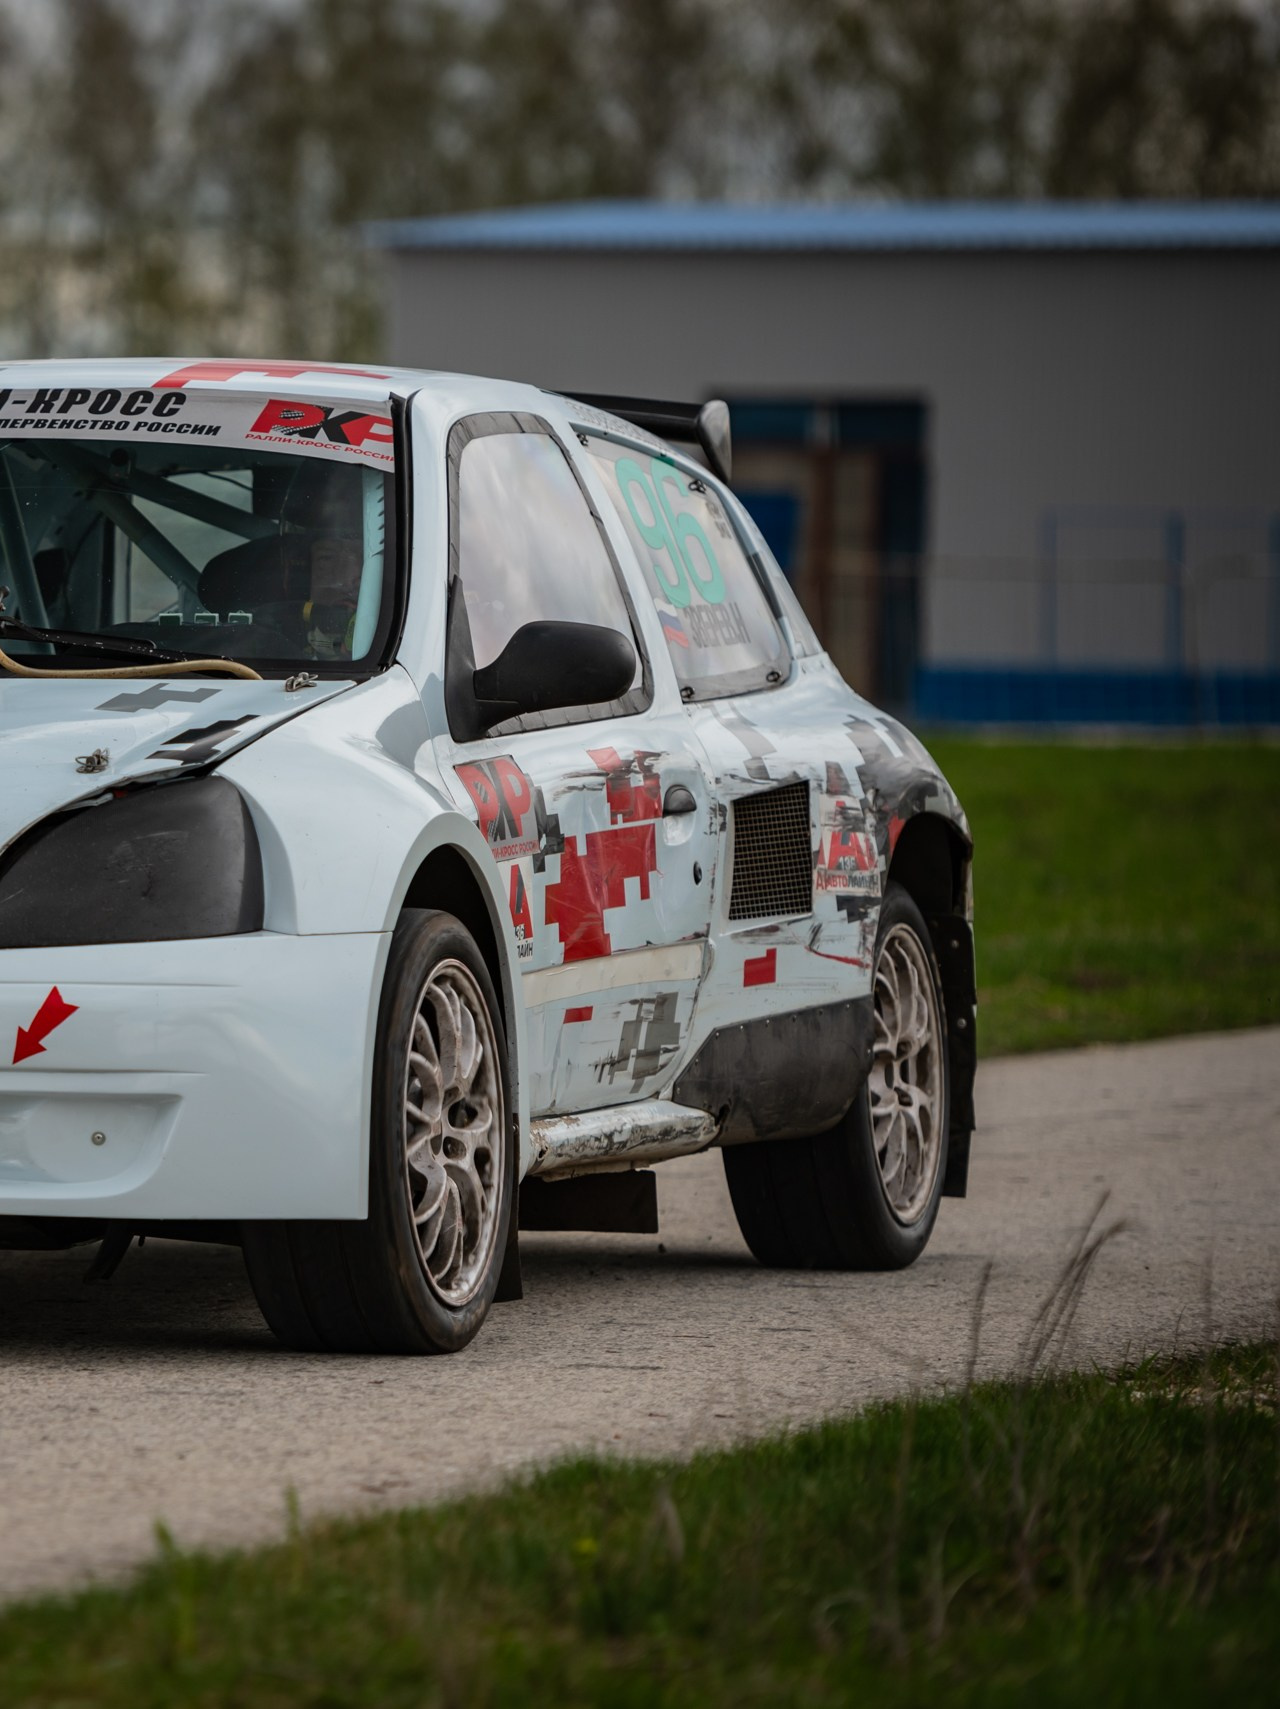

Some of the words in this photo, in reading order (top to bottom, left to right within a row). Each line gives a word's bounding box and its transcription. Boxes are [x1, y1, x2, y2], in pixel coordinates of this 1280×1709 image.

[133, 421, 222, 436] РОССИИ
[245, 433, 342, 451] РАЛЛИ-КРОСС
[615, 457, 726, 608] 96
